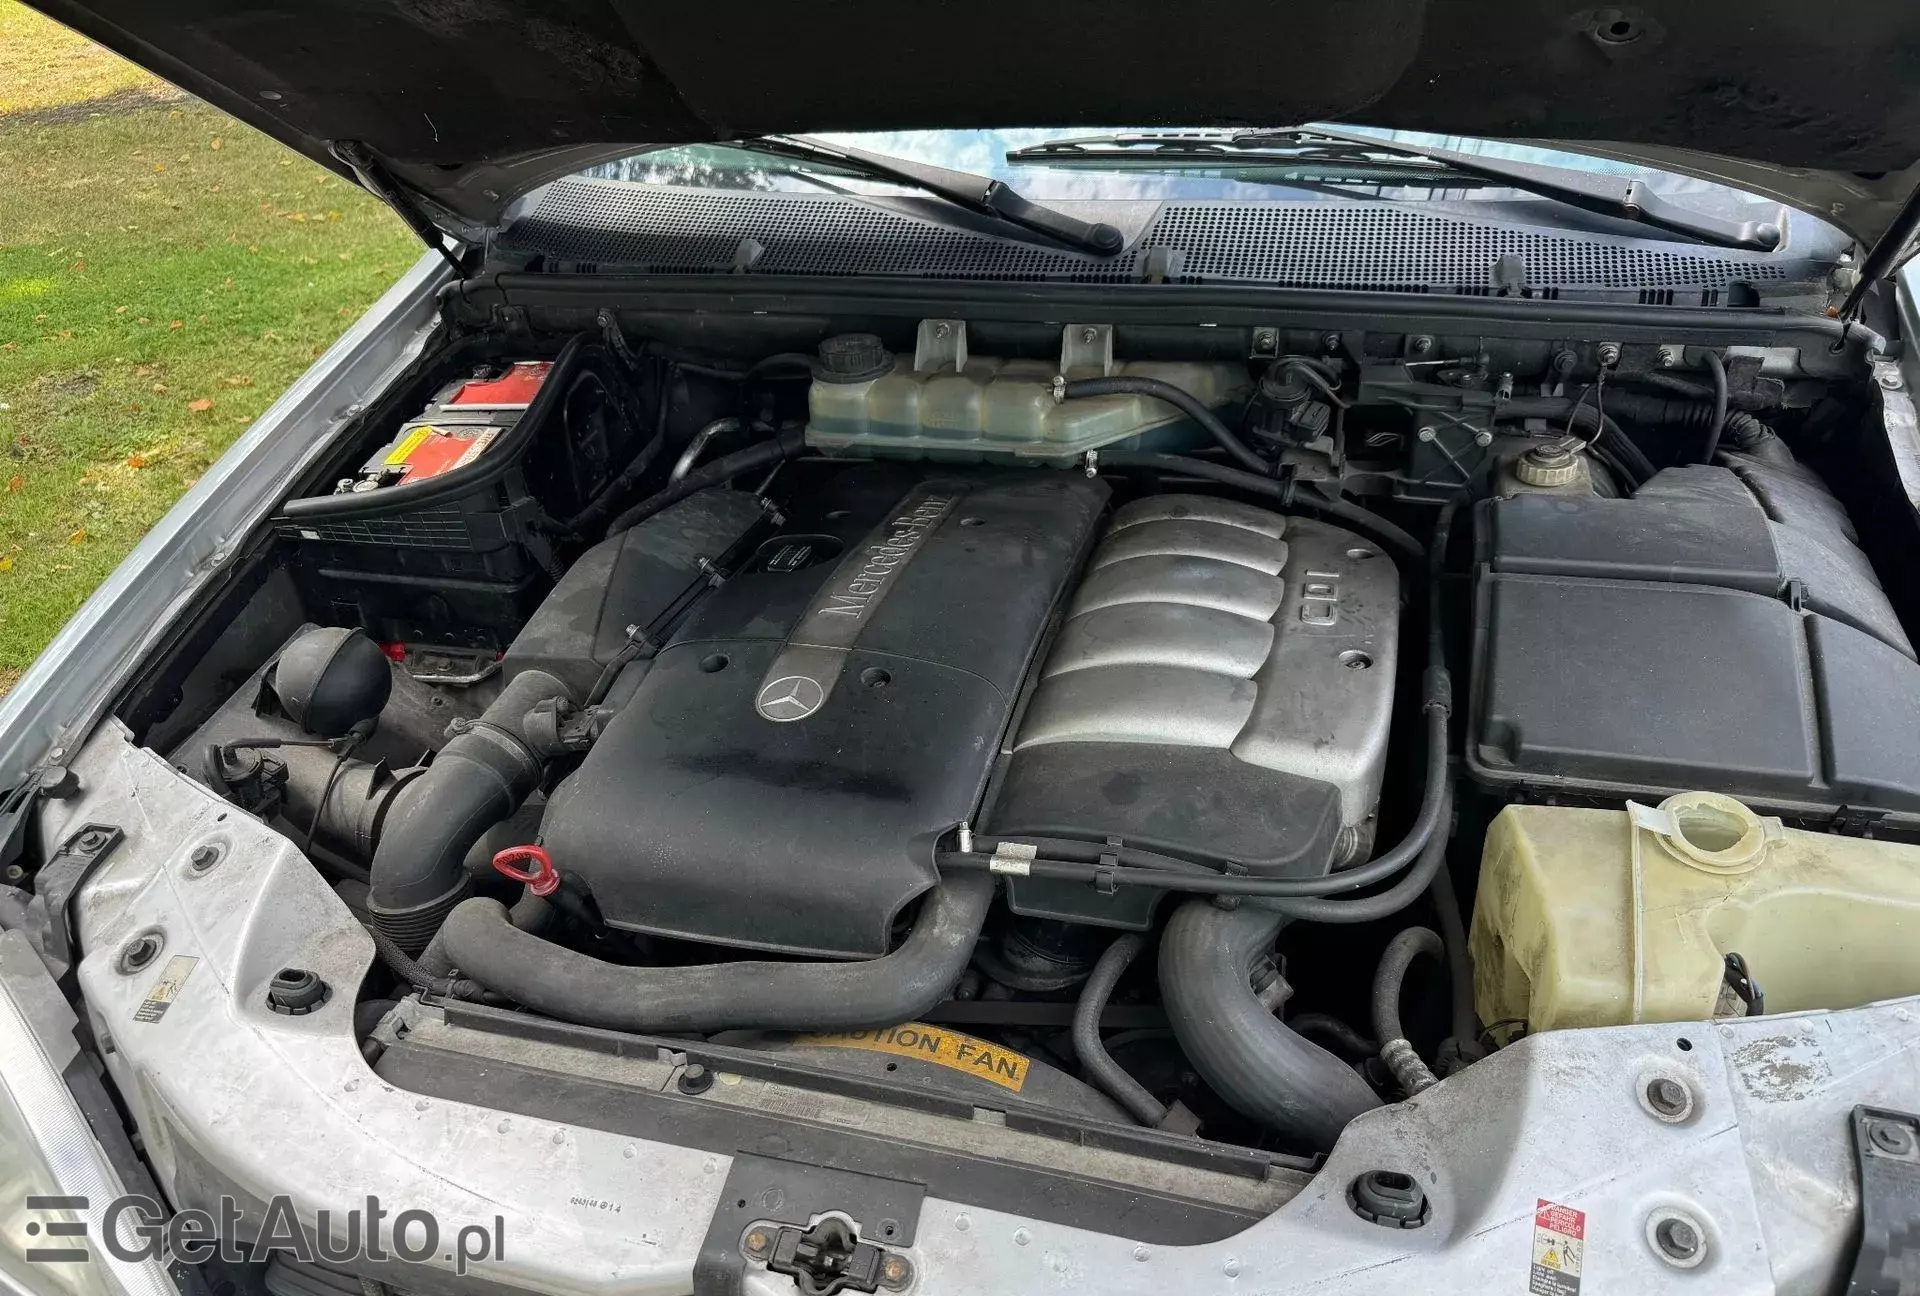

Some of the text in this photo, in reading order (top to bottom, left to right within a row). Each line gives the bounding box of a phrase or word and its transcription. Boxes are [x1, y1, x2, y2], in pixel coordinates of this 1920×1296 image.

[818, 495, 949, 619] Mercedes-Benz
[1300, 569, 1341, 626] CDI
[956, 1043, 1018, 1079] FAN
